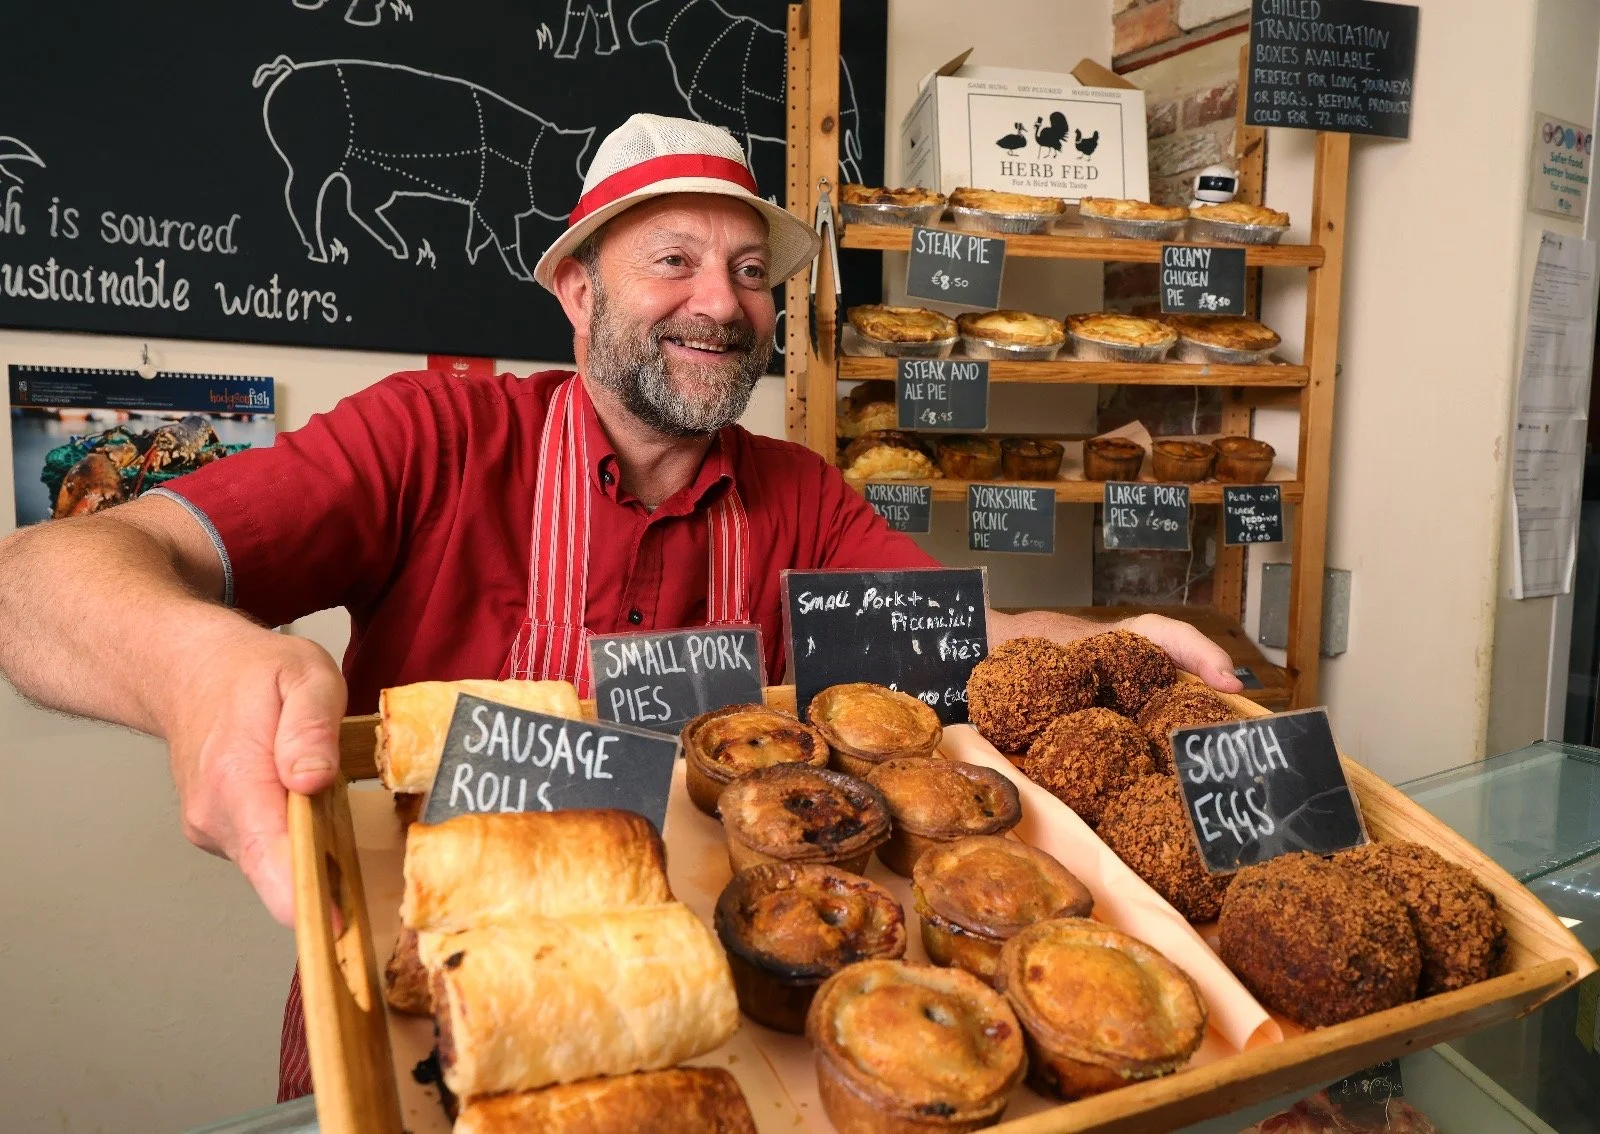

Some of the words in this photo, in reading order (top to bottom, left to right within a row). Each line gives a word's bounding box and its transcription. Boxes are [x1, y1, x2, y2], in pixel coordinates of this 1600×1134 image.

[1261, 0, 1321, 20] CHILLED
[1255, 18, 1390, 49] TRANSPORTATION
[1256, 44, 1299, 64] BOXES
[1254, 68, 1301, 86] PERFECT
[1308, 72, 1327, 88] FOR
[1331, 74, 1357, 92] LONG
[1254, 91, 1269, 104] OR
[1318, 93, 1362, 111] KEEPING
[1254, 109, 1281, 122] COLD
[1287, 109, 1308, 124] FOR
[1316, 111, 1332, 126] 72
[1000, 161, 1053, 178] HERB
[1062, 165, 1098, 180] FED
[0, 186, 25, 236] h
[48, 197, 79, 239] is
[100, 210, 241, 255] sourced
[916, 230, 962, 260] STEAK
[967, 236, 991, 264] PIE
[1164, 247, 1211, 269] CREAMY
[1163, 269, 1208, 287] CHICKEN
[0, 257, 190, 311] ustainable
[215, 273, 353, 323] waters.
[1167, 288, 1185, 306] PIE
[904, 360, 945, 381] STEAK
[951, 362, 979, 381] AND
[904, 383, 924, 400] ALE
[928, 383, 946, 400] PIE
[867, 485, 930, 505] YORKSHIRE
[971, 486, 1037, 511] YORKSHIRE
[1109, 485, 1147, 506] LARGE
[1154, 485, 1187, 508] PORK
[973, 511, 1008, 532] PICNIC
[1110, 507, 1138, 528] PIES
[974, 532, 990, 549] PIE
[604, 640, 686, 679] SMALL
[687, 634, 752, 674] PORK
[610, 685, 671, 723] PIES
[944, 687, 969, 707] Eac
[463, 705, 620, 780] SAUSAGE
[1185, 725, 1289, 784] SCOTCH
[1194, 787, 1275, 845] EGGS
